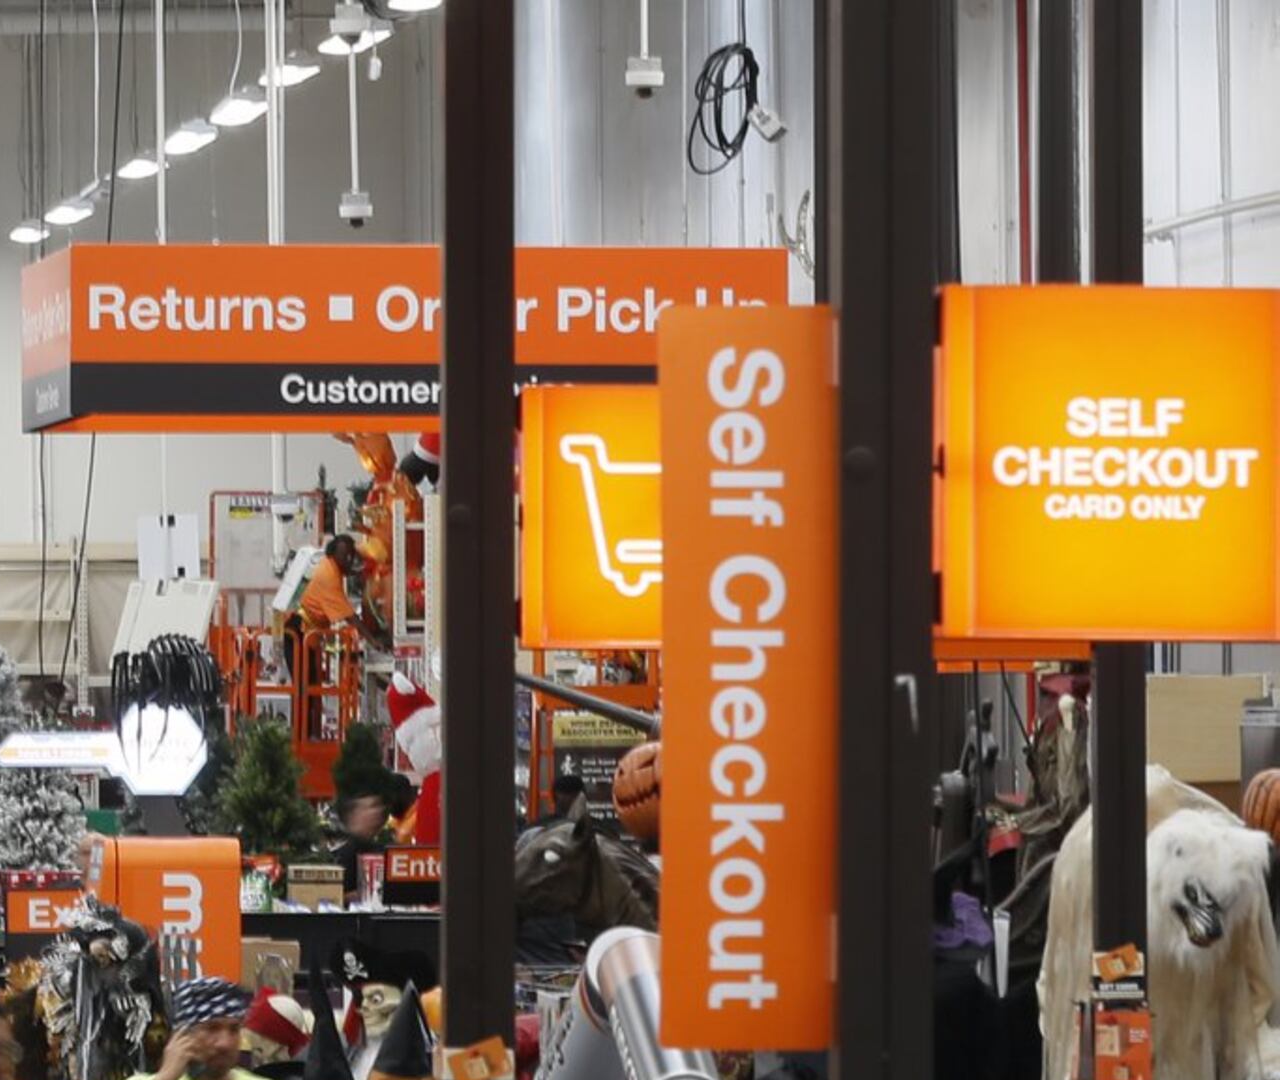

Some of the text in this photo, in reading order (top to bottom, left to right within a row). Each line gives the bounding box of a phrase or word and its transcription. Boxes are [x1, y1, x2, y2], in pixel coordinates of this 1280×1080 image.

[87, 284, 307, 332] Returns
[375, 285, 538, 332] Orr
[280, 373, 442, 404] Customer
[706, 345, 786, 527] Self
[1065, 397, 1185, 438] SELF
[991, 447, 1260, 488] CHECKOUT
[1043, 495, 1206, 520] CARD ONLY
[707, 553, 786, 1010] Checkout
